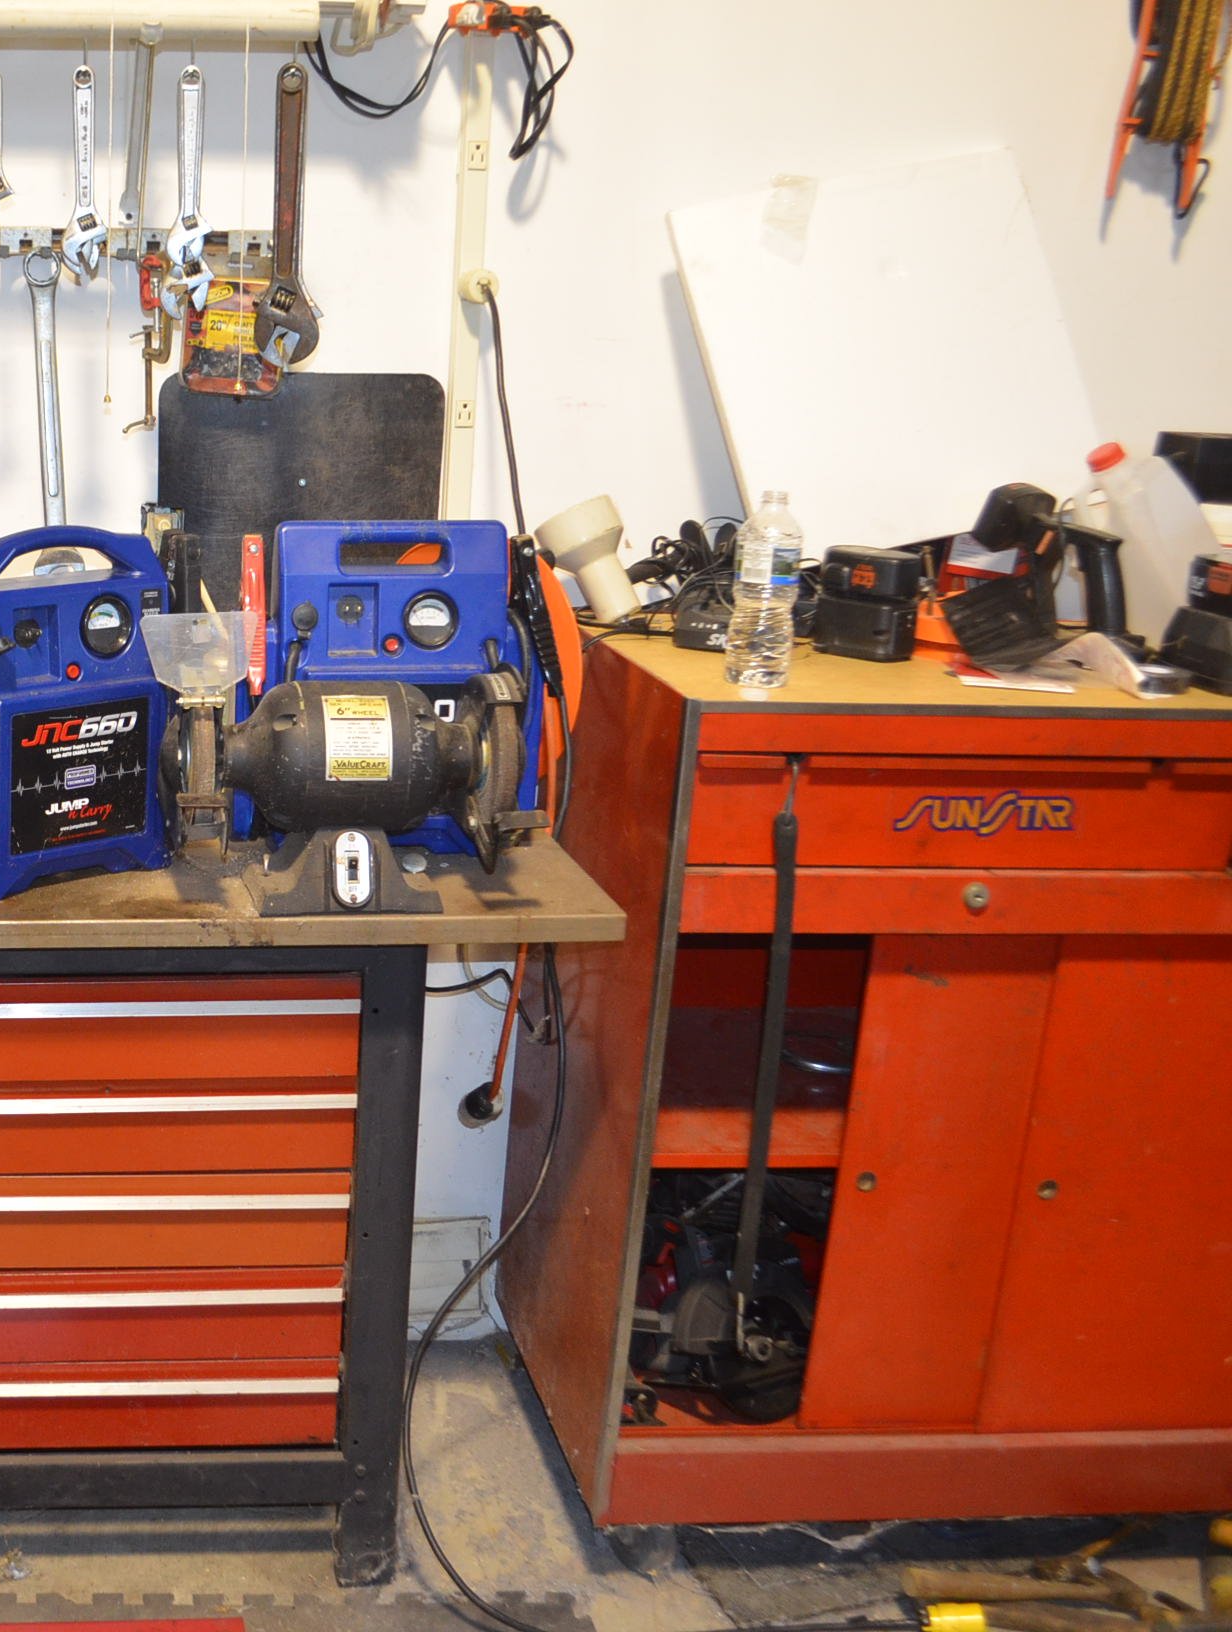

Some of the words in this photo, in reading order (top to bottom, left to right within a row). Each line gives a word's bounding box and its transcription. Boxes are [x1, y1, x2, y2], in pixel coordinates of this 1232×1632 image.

[337, 707, 351, 715] 6"
[45, 797, 89, 815] JUMP
[80, 803, 113, 821] Carry
[893, 790, 1076, 837] SUNSTAR
